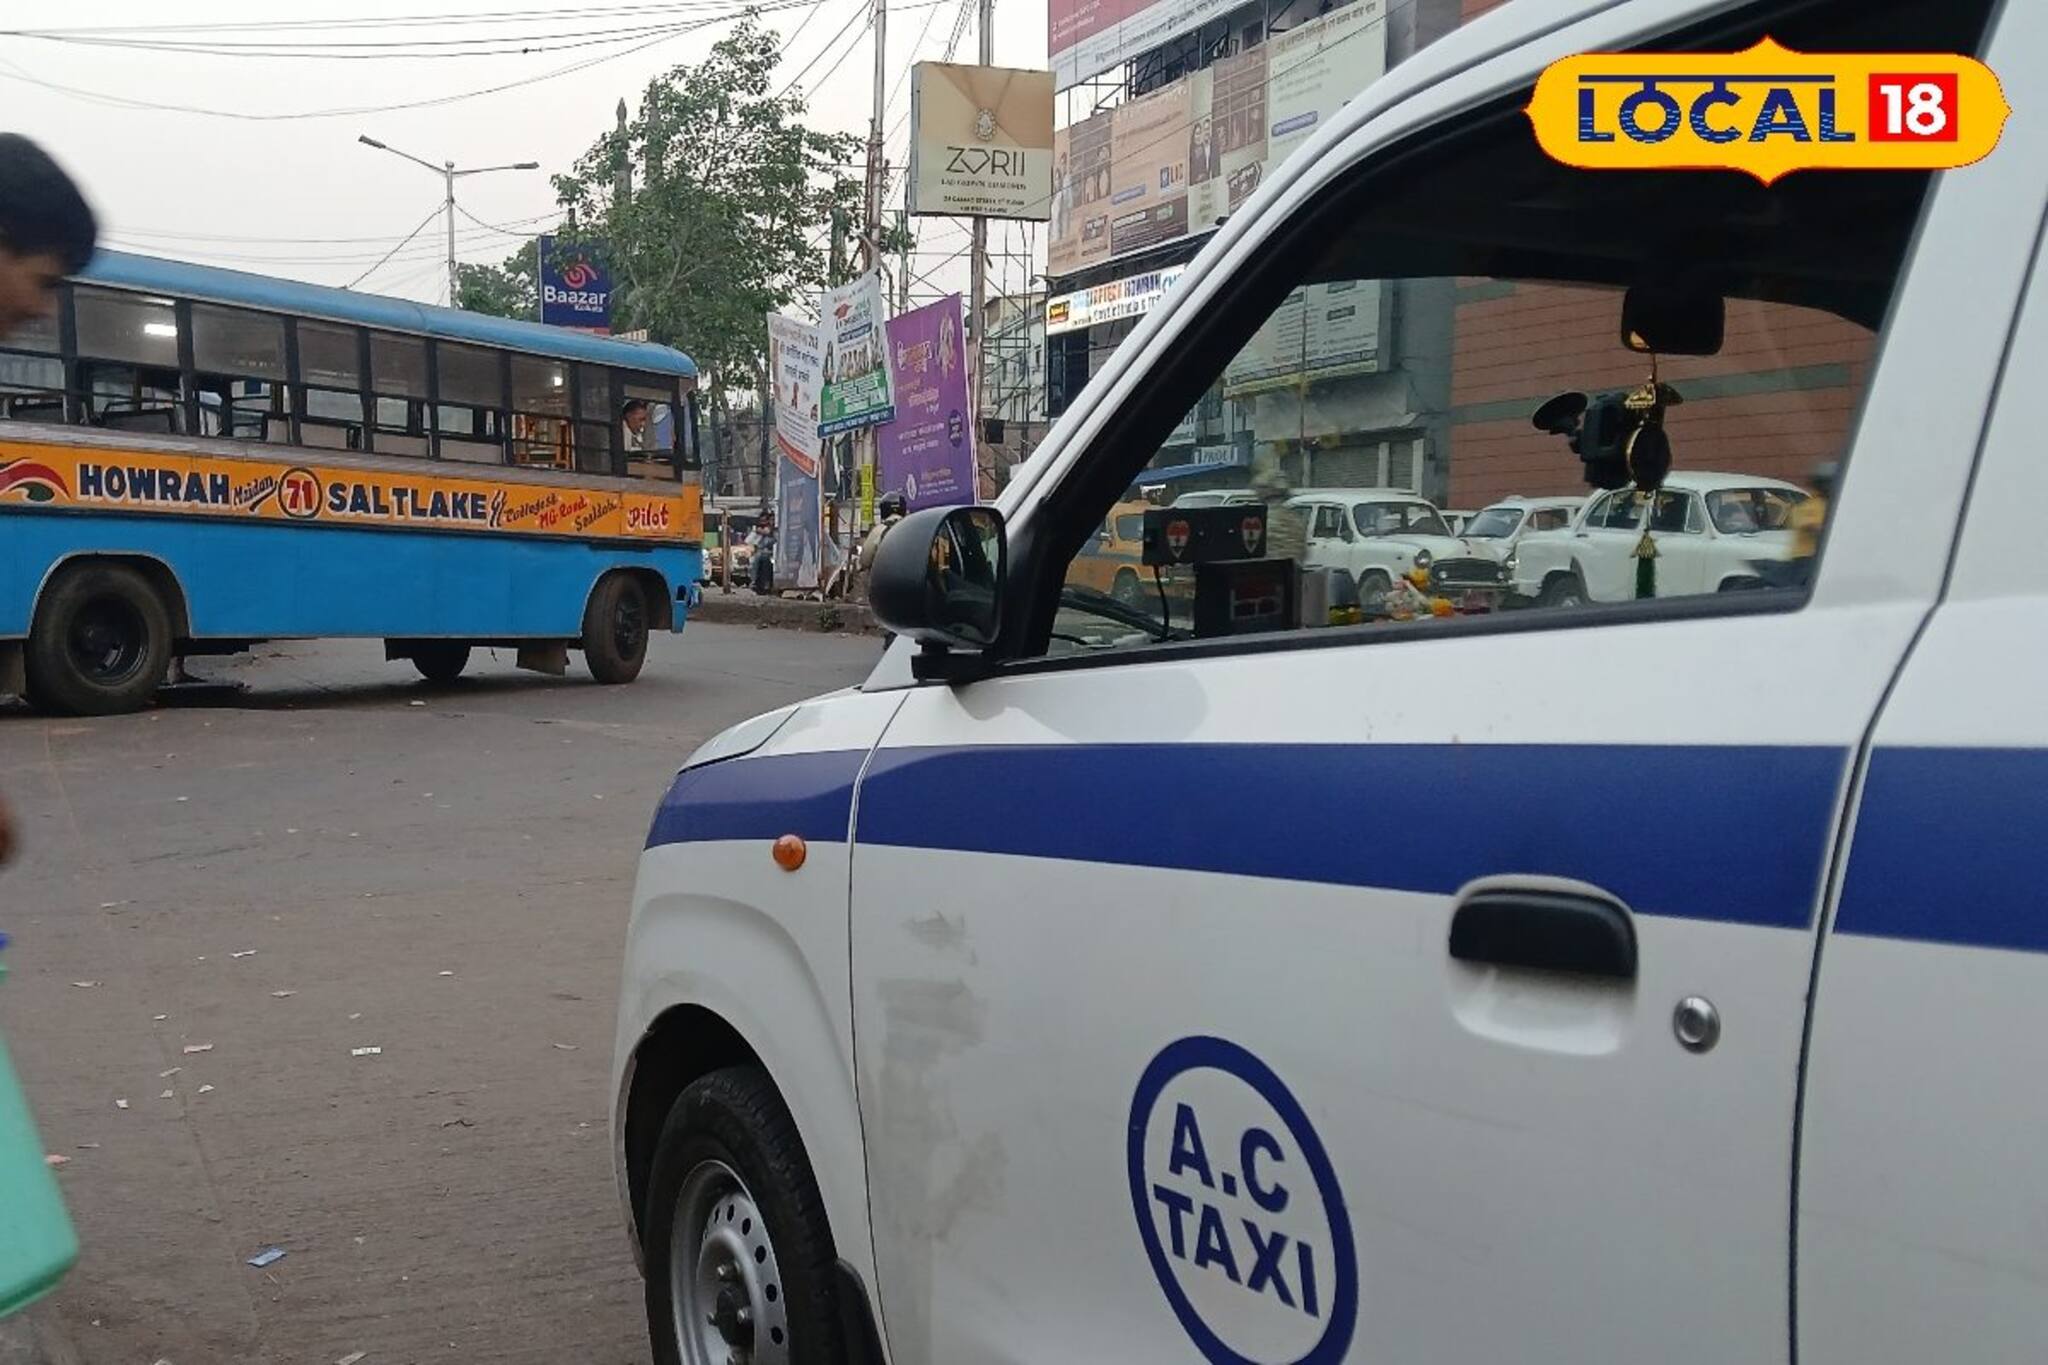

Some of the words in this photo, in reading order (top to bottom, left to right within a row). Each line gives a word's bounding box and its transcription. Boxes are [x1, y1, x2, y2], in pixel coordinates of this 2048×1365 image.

[945, 146, 1025, 176] ZORII
[543, 285, 607, 305] Baazar
[78, 463, 231, 506] HOWRAH
[286, 479, 314, 510] 71
[627, 502, 669, 530] Pilot
[1168, 1102, 1290, 1214] A.C
[1152, 1183, 1320, 1319] TAXI
